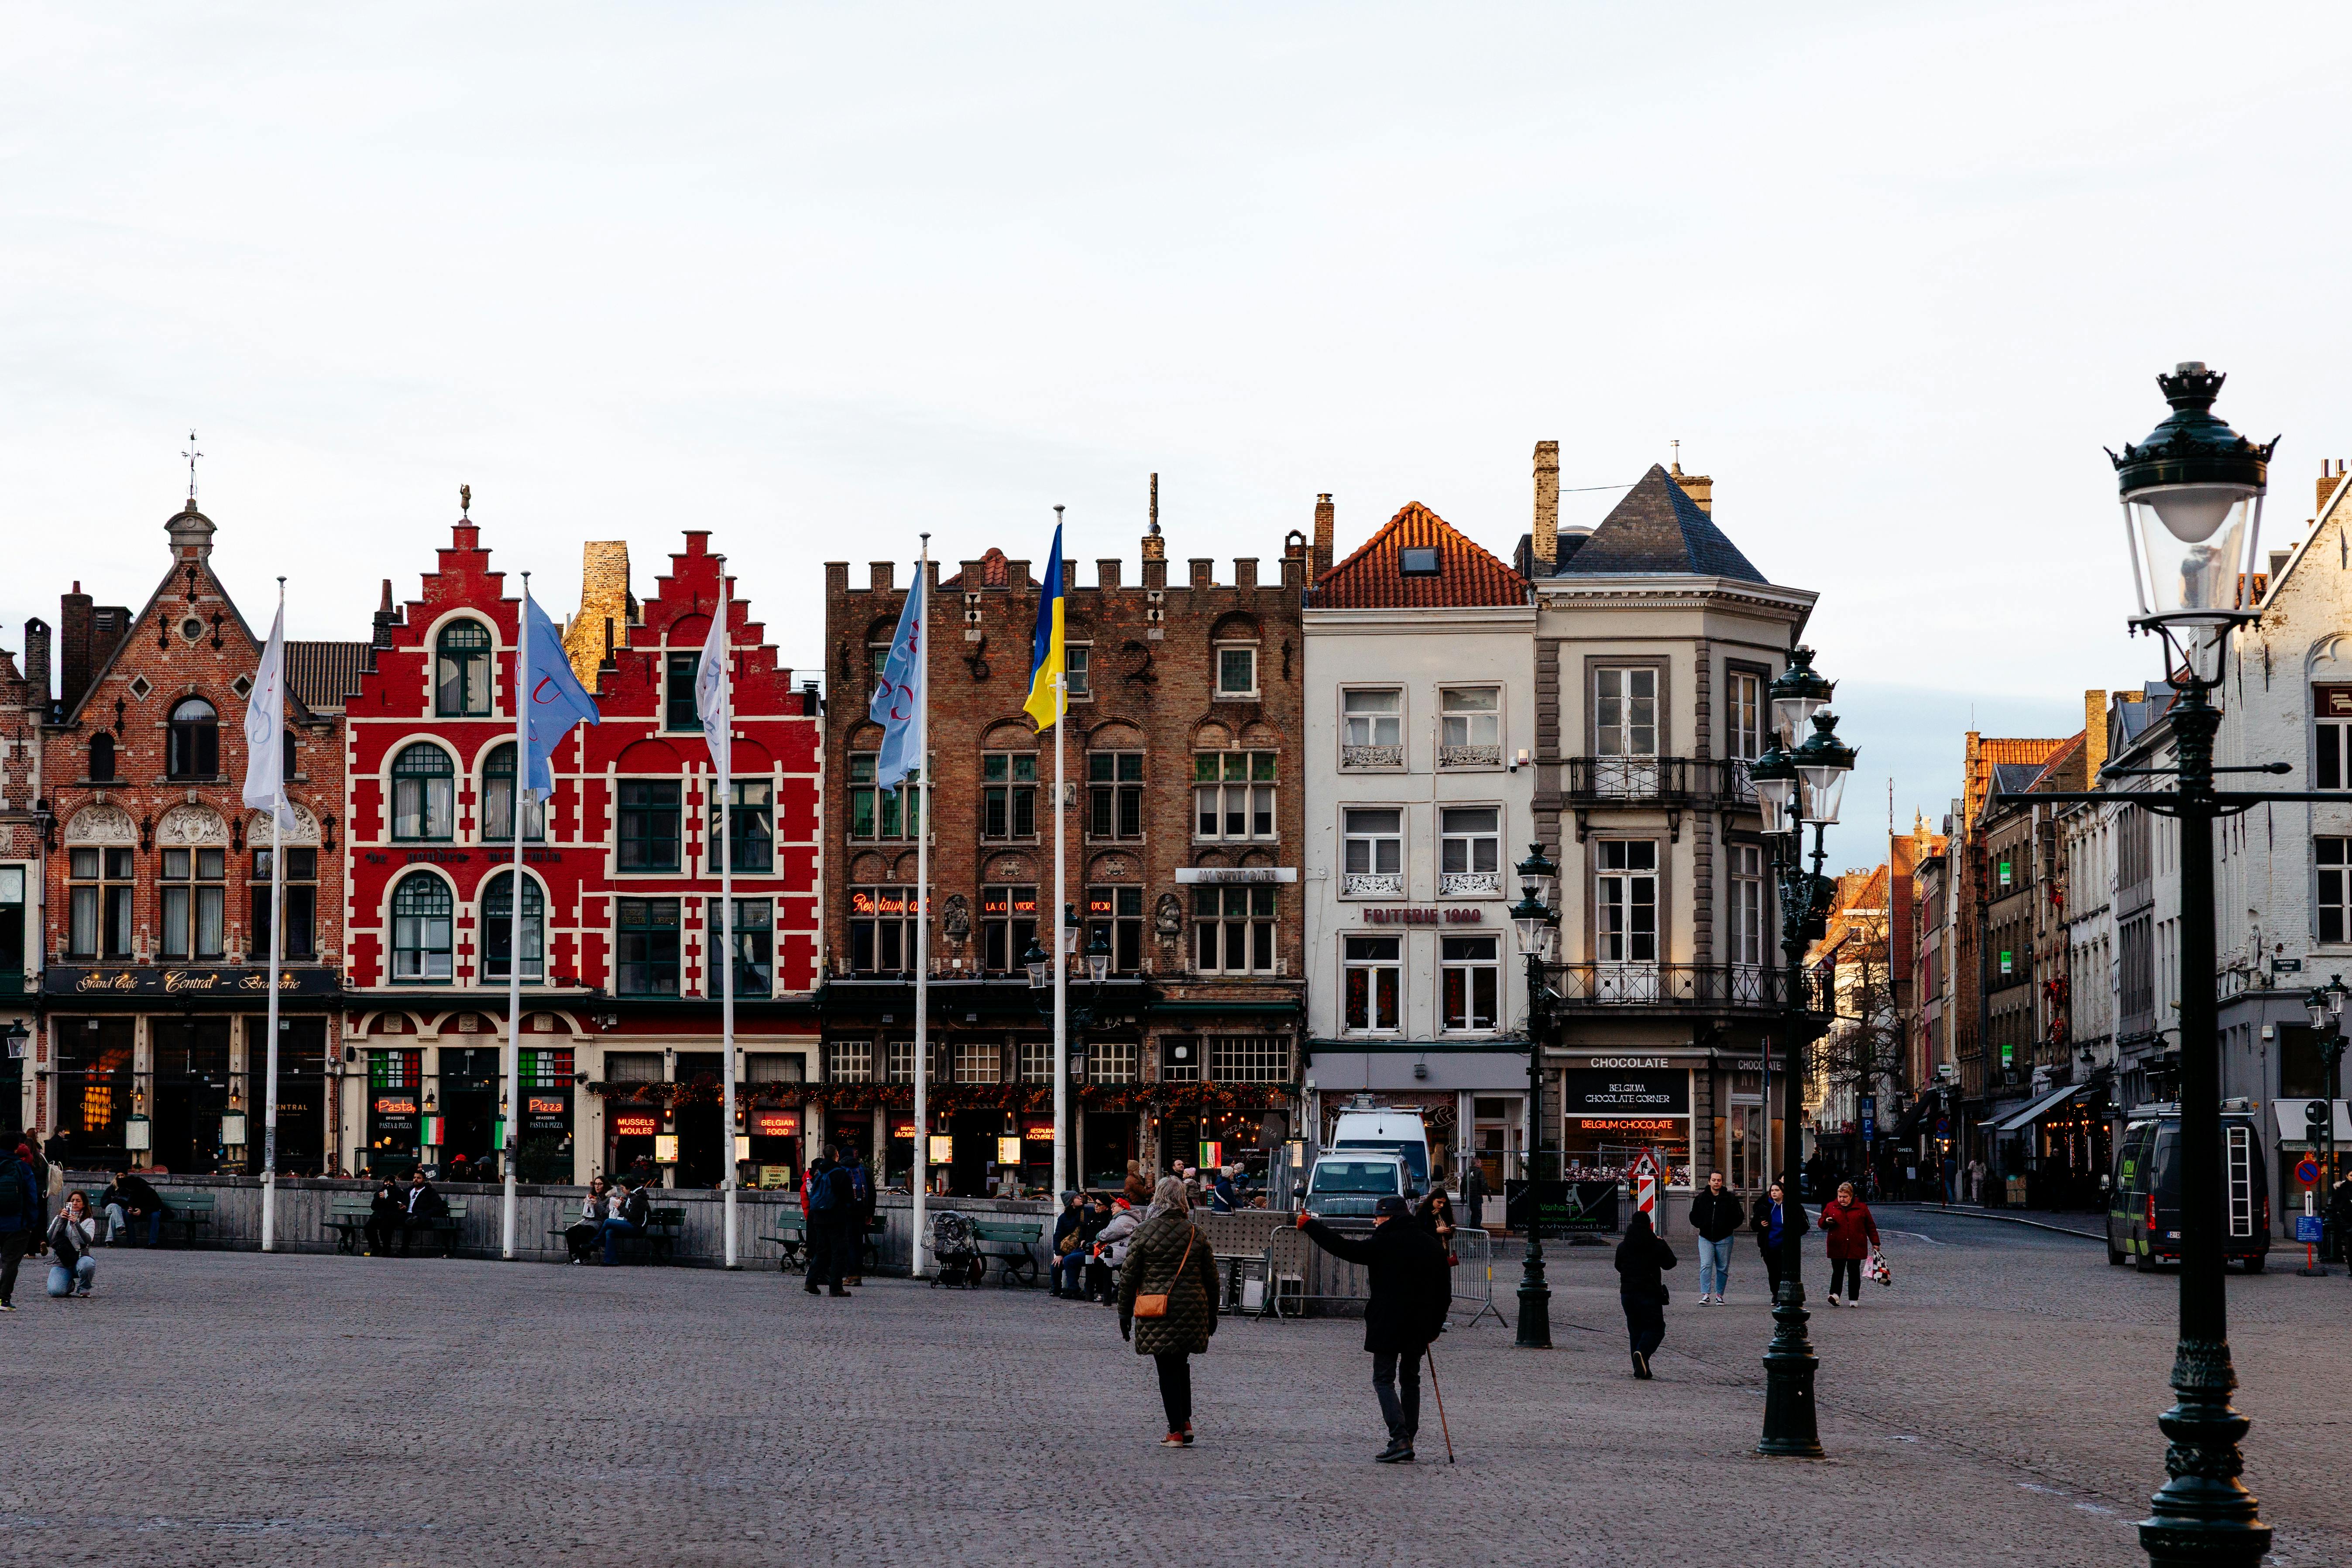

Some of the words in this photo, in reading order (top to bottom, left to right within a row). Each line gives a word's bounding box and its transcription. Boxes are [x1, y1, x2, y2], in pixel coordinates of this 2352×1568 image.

[1198, 870, 1212, 882] AU
[1215, 870, 1246, 882] PETIT
[853, 893, 931, 913] Restaurat
[985, 902, 996, 911] LA
[1363, 909, 1438, 923] FRITERIE
[1443, 909, 1481, 923] 1900
[76, 976, 113, 992] Grand
[165, 971, 216, 993] Central
[239, 977, 301, 989] Braerie
[1590, 1058, 1669, 1068] CHOCOLATE
[1738, 1060, 1781, 1071] CHOCOATE
[378, 1099, 413, 1113] Pasta
[529, 1099, 563, 1112] Pizza
[1222, 1123, 1244, 1138] PIZZA
[1582, 1120, 1618, 1129] BELGIUM
[1620, 1120, 1672, 1129] CHOCOLATE
